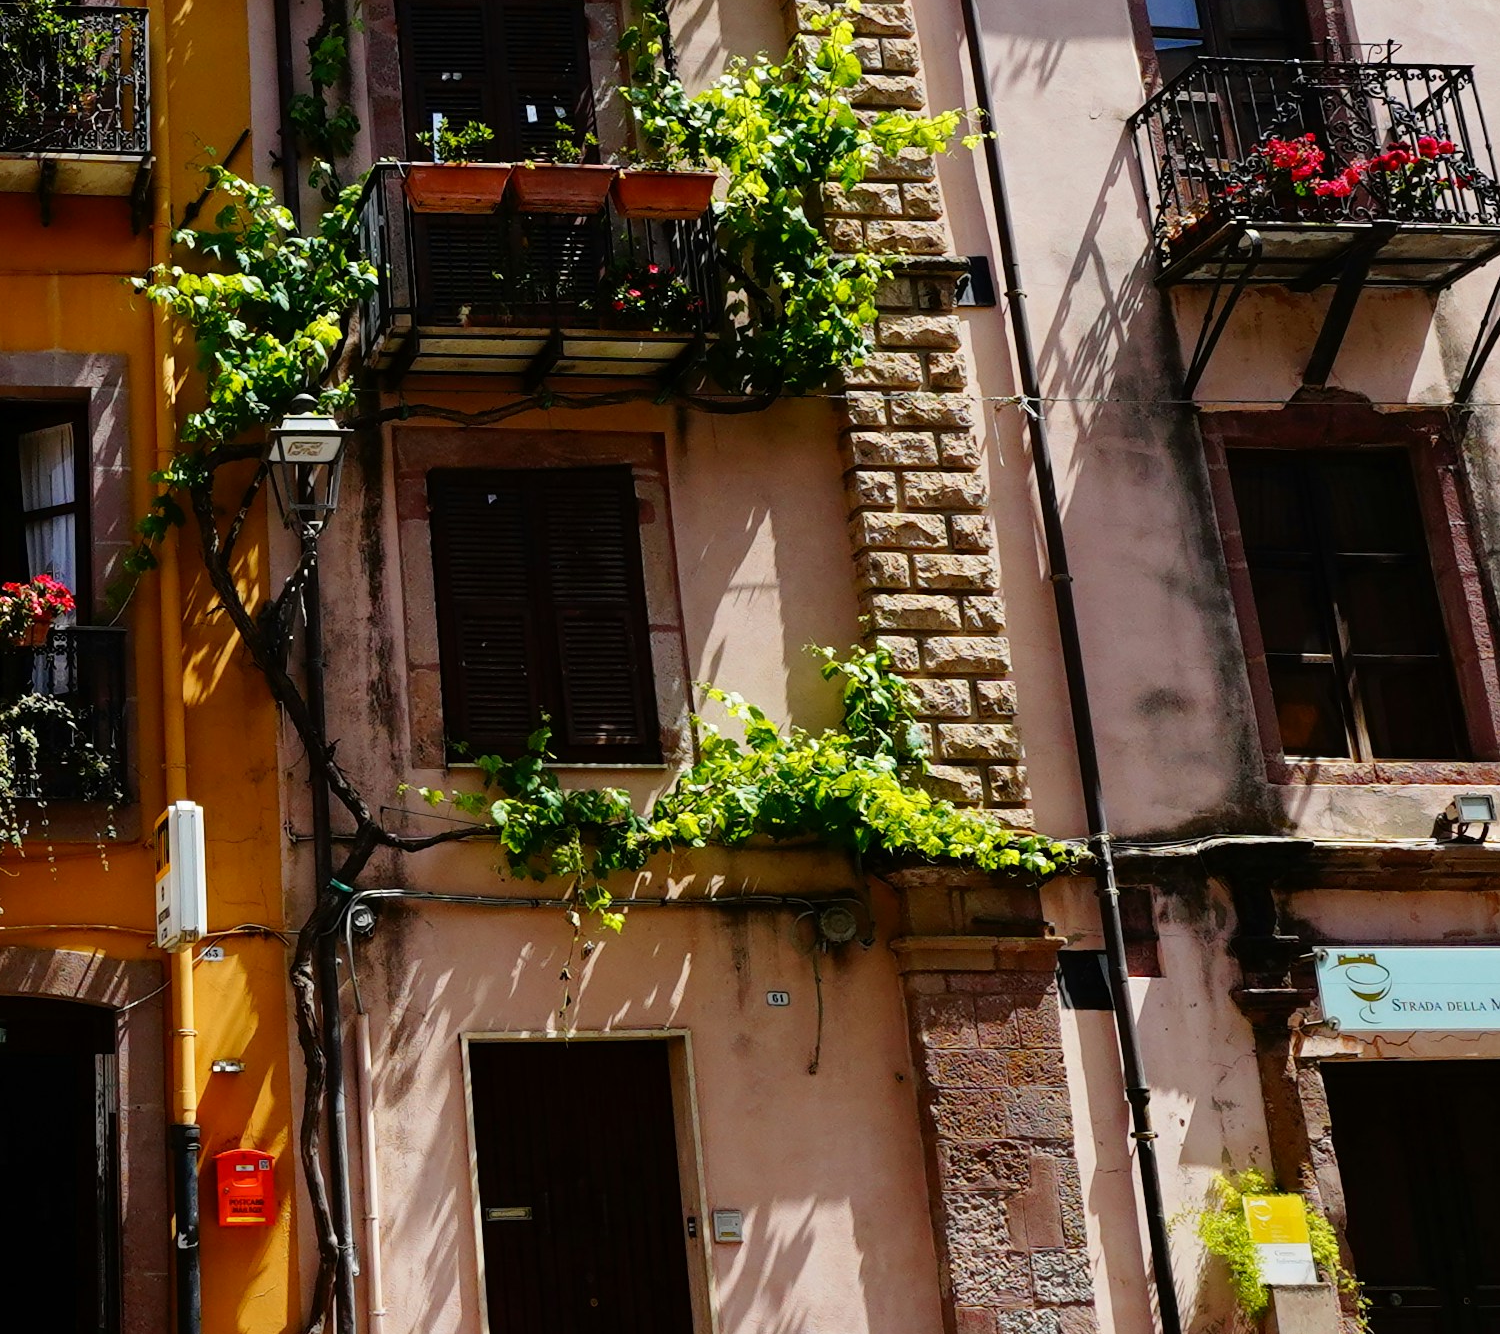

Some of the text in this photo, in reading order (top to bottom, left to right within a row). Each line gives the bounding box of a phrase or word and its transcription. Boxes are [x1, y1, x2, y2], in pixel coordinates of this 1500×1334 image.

[772, 993, 784, 1003] 61
[1391, 998, 1441, 1012] STRADA
[1447, 1001, 1487, 1012] DELLA
